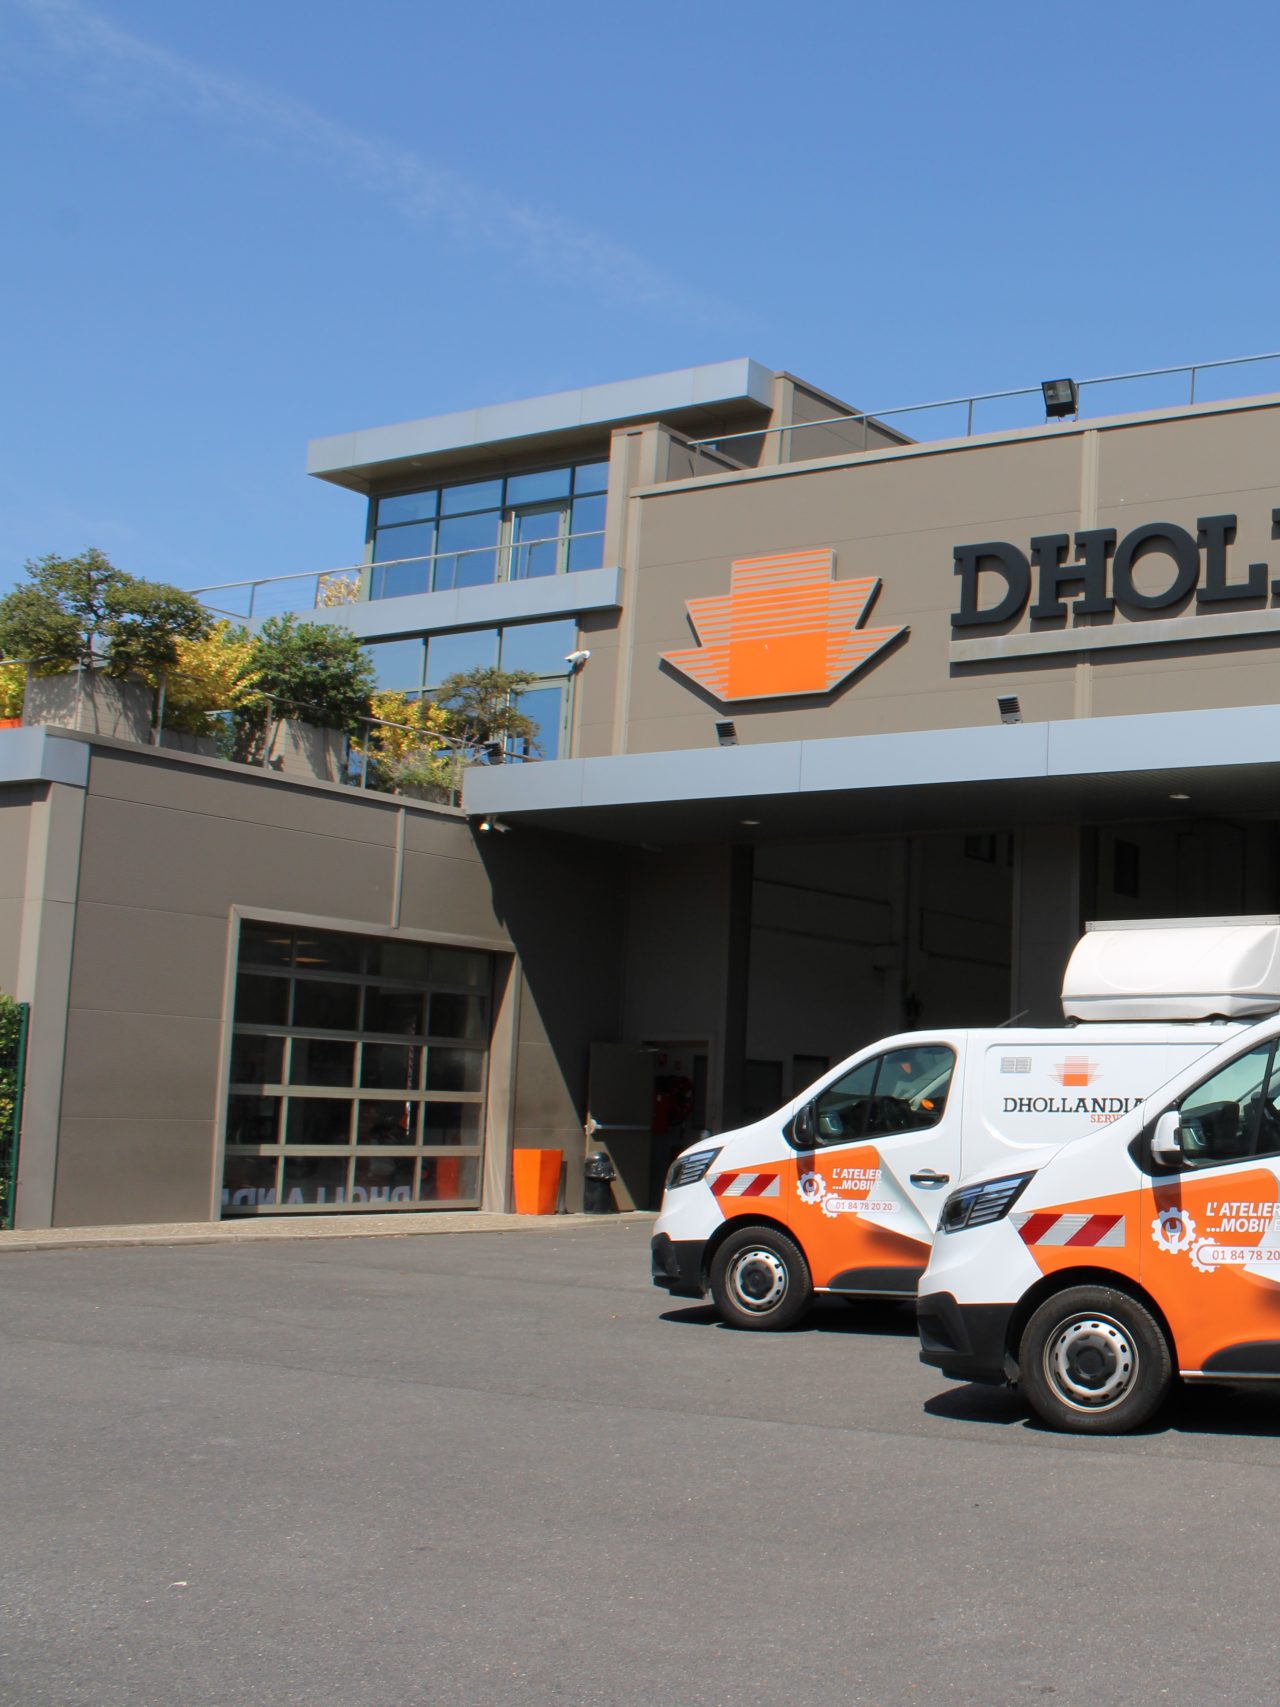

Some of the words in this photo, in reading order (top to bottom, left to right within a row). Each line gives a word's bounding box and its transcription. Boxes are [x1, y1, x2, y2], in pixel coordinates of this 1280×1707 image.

[836, 1202, 846, 1210] 01
[848, 1202, 858, 1210] 84
[860, 1202, 870, 1211] 78
[871, 1203, 881, 1211] 20
[883, 1203, 893, 1211] 20
[1212, 1249, 1226, 1261] 01
[1230, 1249, 1245, 1261] 84
[1249, 1250, 1263, 1261] 78
[1266, 1250, 1280, 1261] 20
